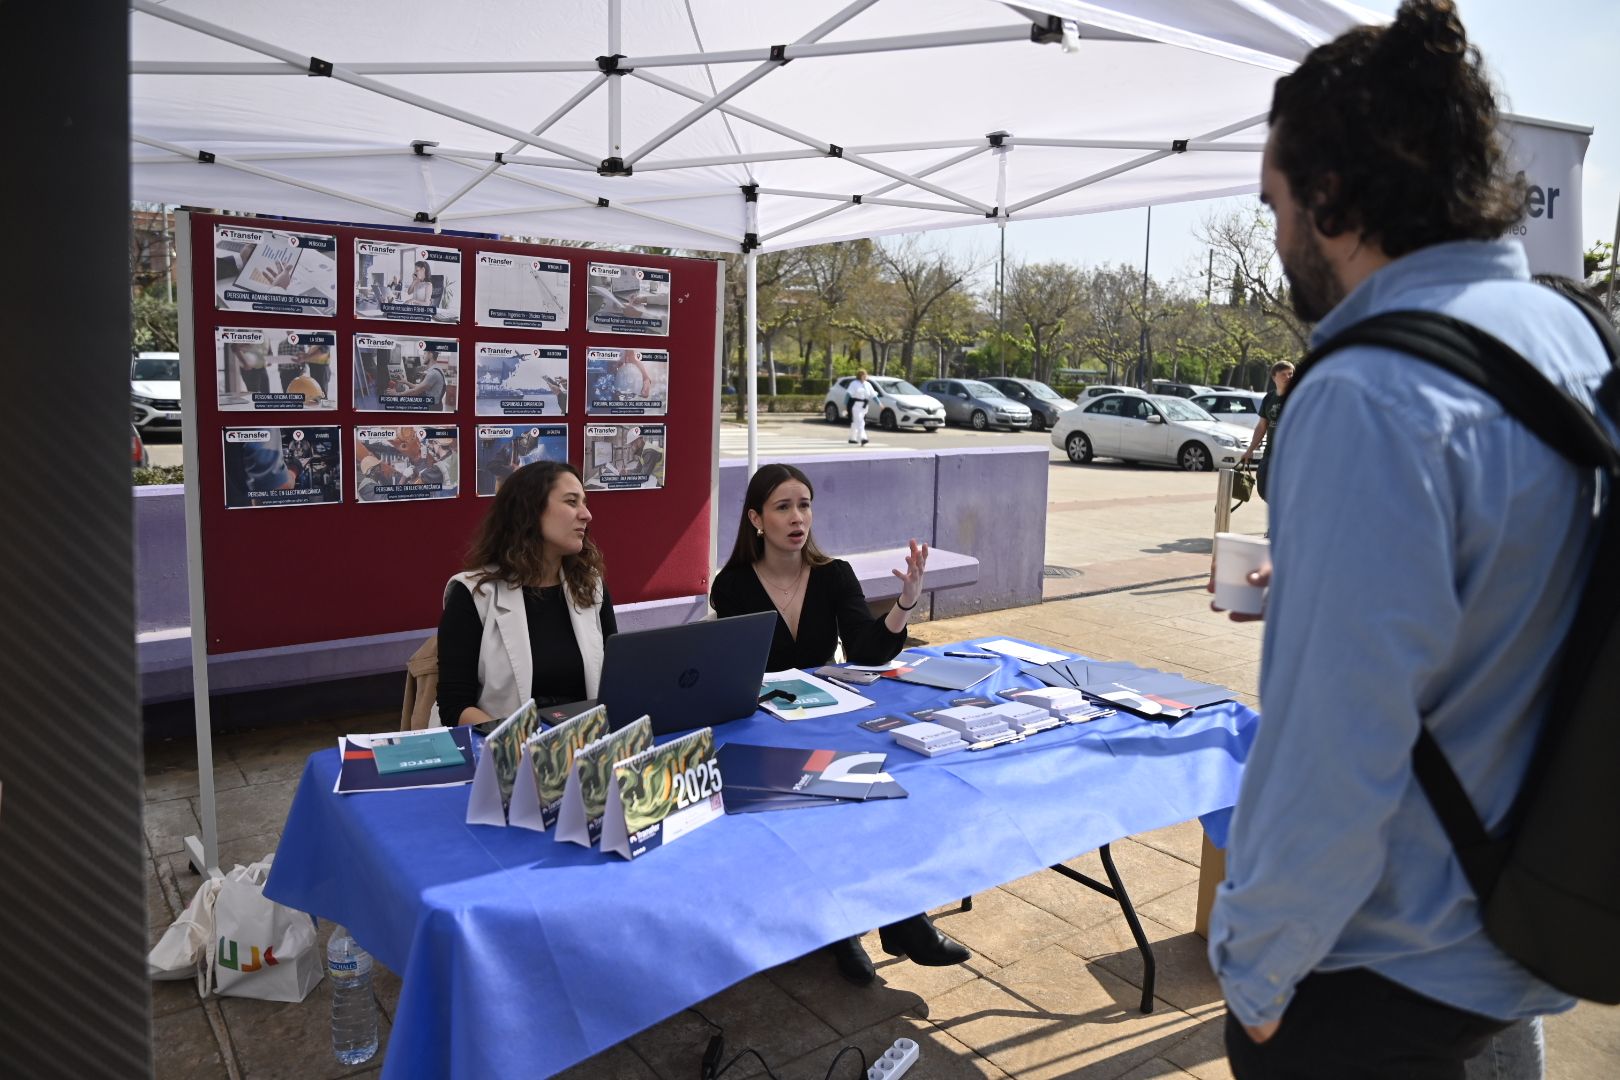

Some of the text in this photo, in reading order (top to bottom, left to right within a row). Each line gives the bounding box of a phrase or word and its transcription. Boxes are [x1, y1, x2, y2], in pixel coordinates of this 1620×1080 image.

[230, 231, 262, 240] Transfer
[368, 245, 396, 254] Transfer
[488, 258, 512, 266] Transfer
[226, 291, 250, 299] PERSONAL
[251, 294, 290, 303] ADMINISTRATIVO
[296, 297, 326, 306] PLANIFICACIÓN
[230, 332, 262, 341] Transfer
[366, 338, 394, 346] Transfer
[367, 430, 395, 438] Transfer
[672, 757, 723, 810] 2025
